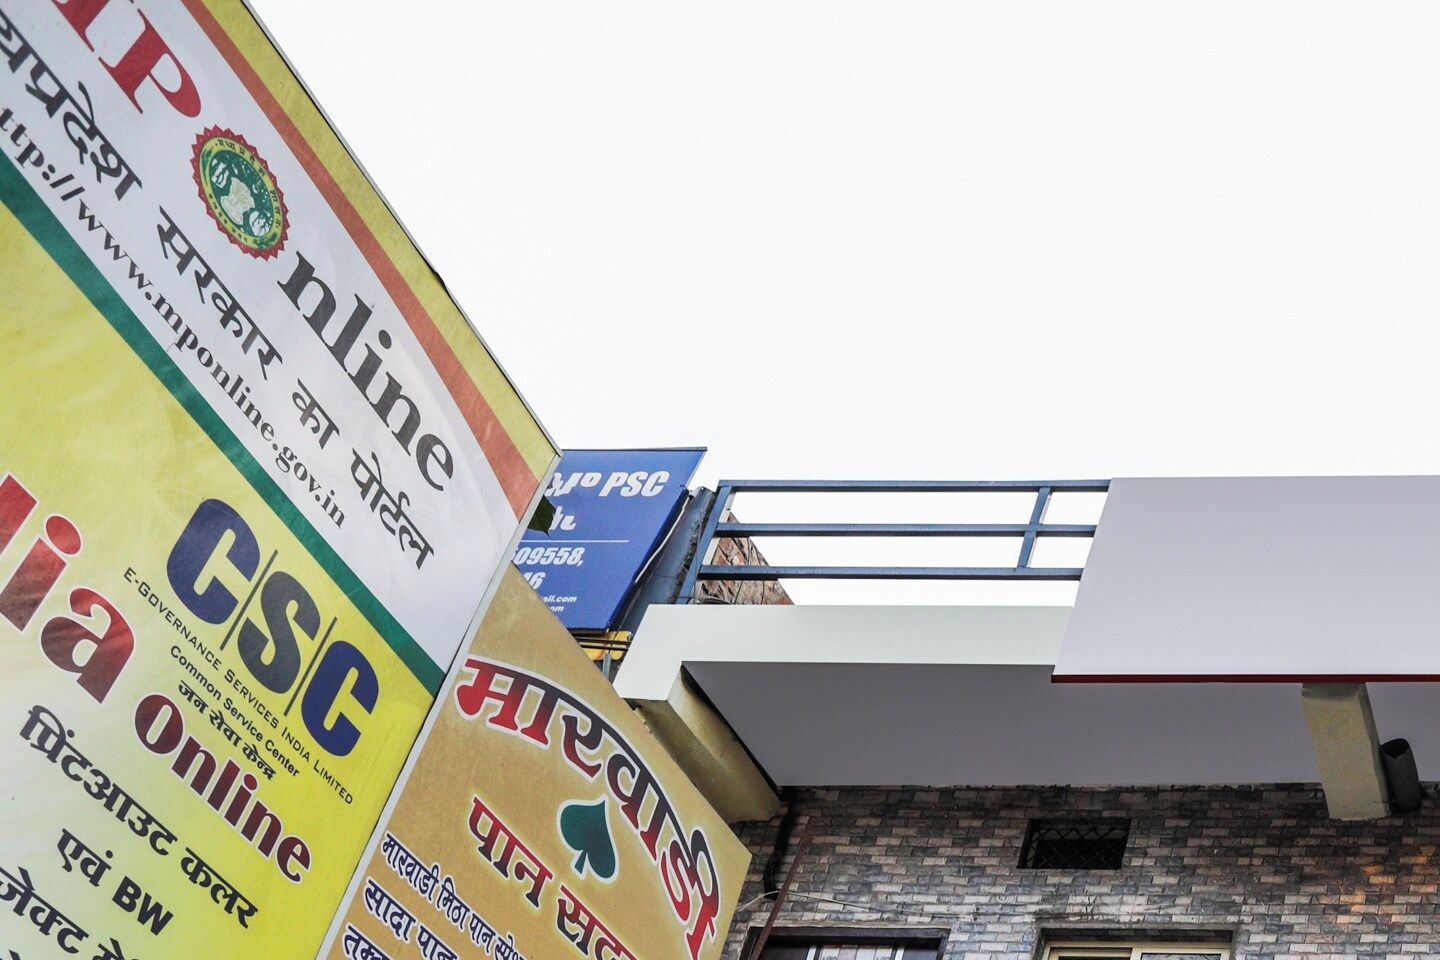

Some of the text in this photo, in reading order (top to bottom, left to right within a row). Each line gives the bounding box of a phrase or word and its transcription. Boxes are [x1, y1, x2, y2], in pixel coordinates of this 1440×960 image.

[0, 108, 346, 529] ttp://www.mponline.gov.in
[157, 206, 282, 380] सरकार
[293, 379, 339, 449] का
[351, 449, 434, 569] पोर्टल
[599, 471, 670, 497] PSC
[514, 547, 586, 566] 09558,
[541, 594, 577, 602] ail.com
[124, 567, 353, 805] E-GOVERNANCE SERVICES INDIA LIMITED
[170, 645, 299, 778] Common Service Center
[179, 680, 276, 781] जन सेवा केन्द्र
[20, 706, 258, 928] प्रिंटआउट कलर
[470, 797, 552, 907] पान
[0, 866, 89, 953] जेक्ट
[58, 829, 173, 935] एवं BW
[365, 880, 416, 940] सादा
[470, 913, 495, 953] पान
